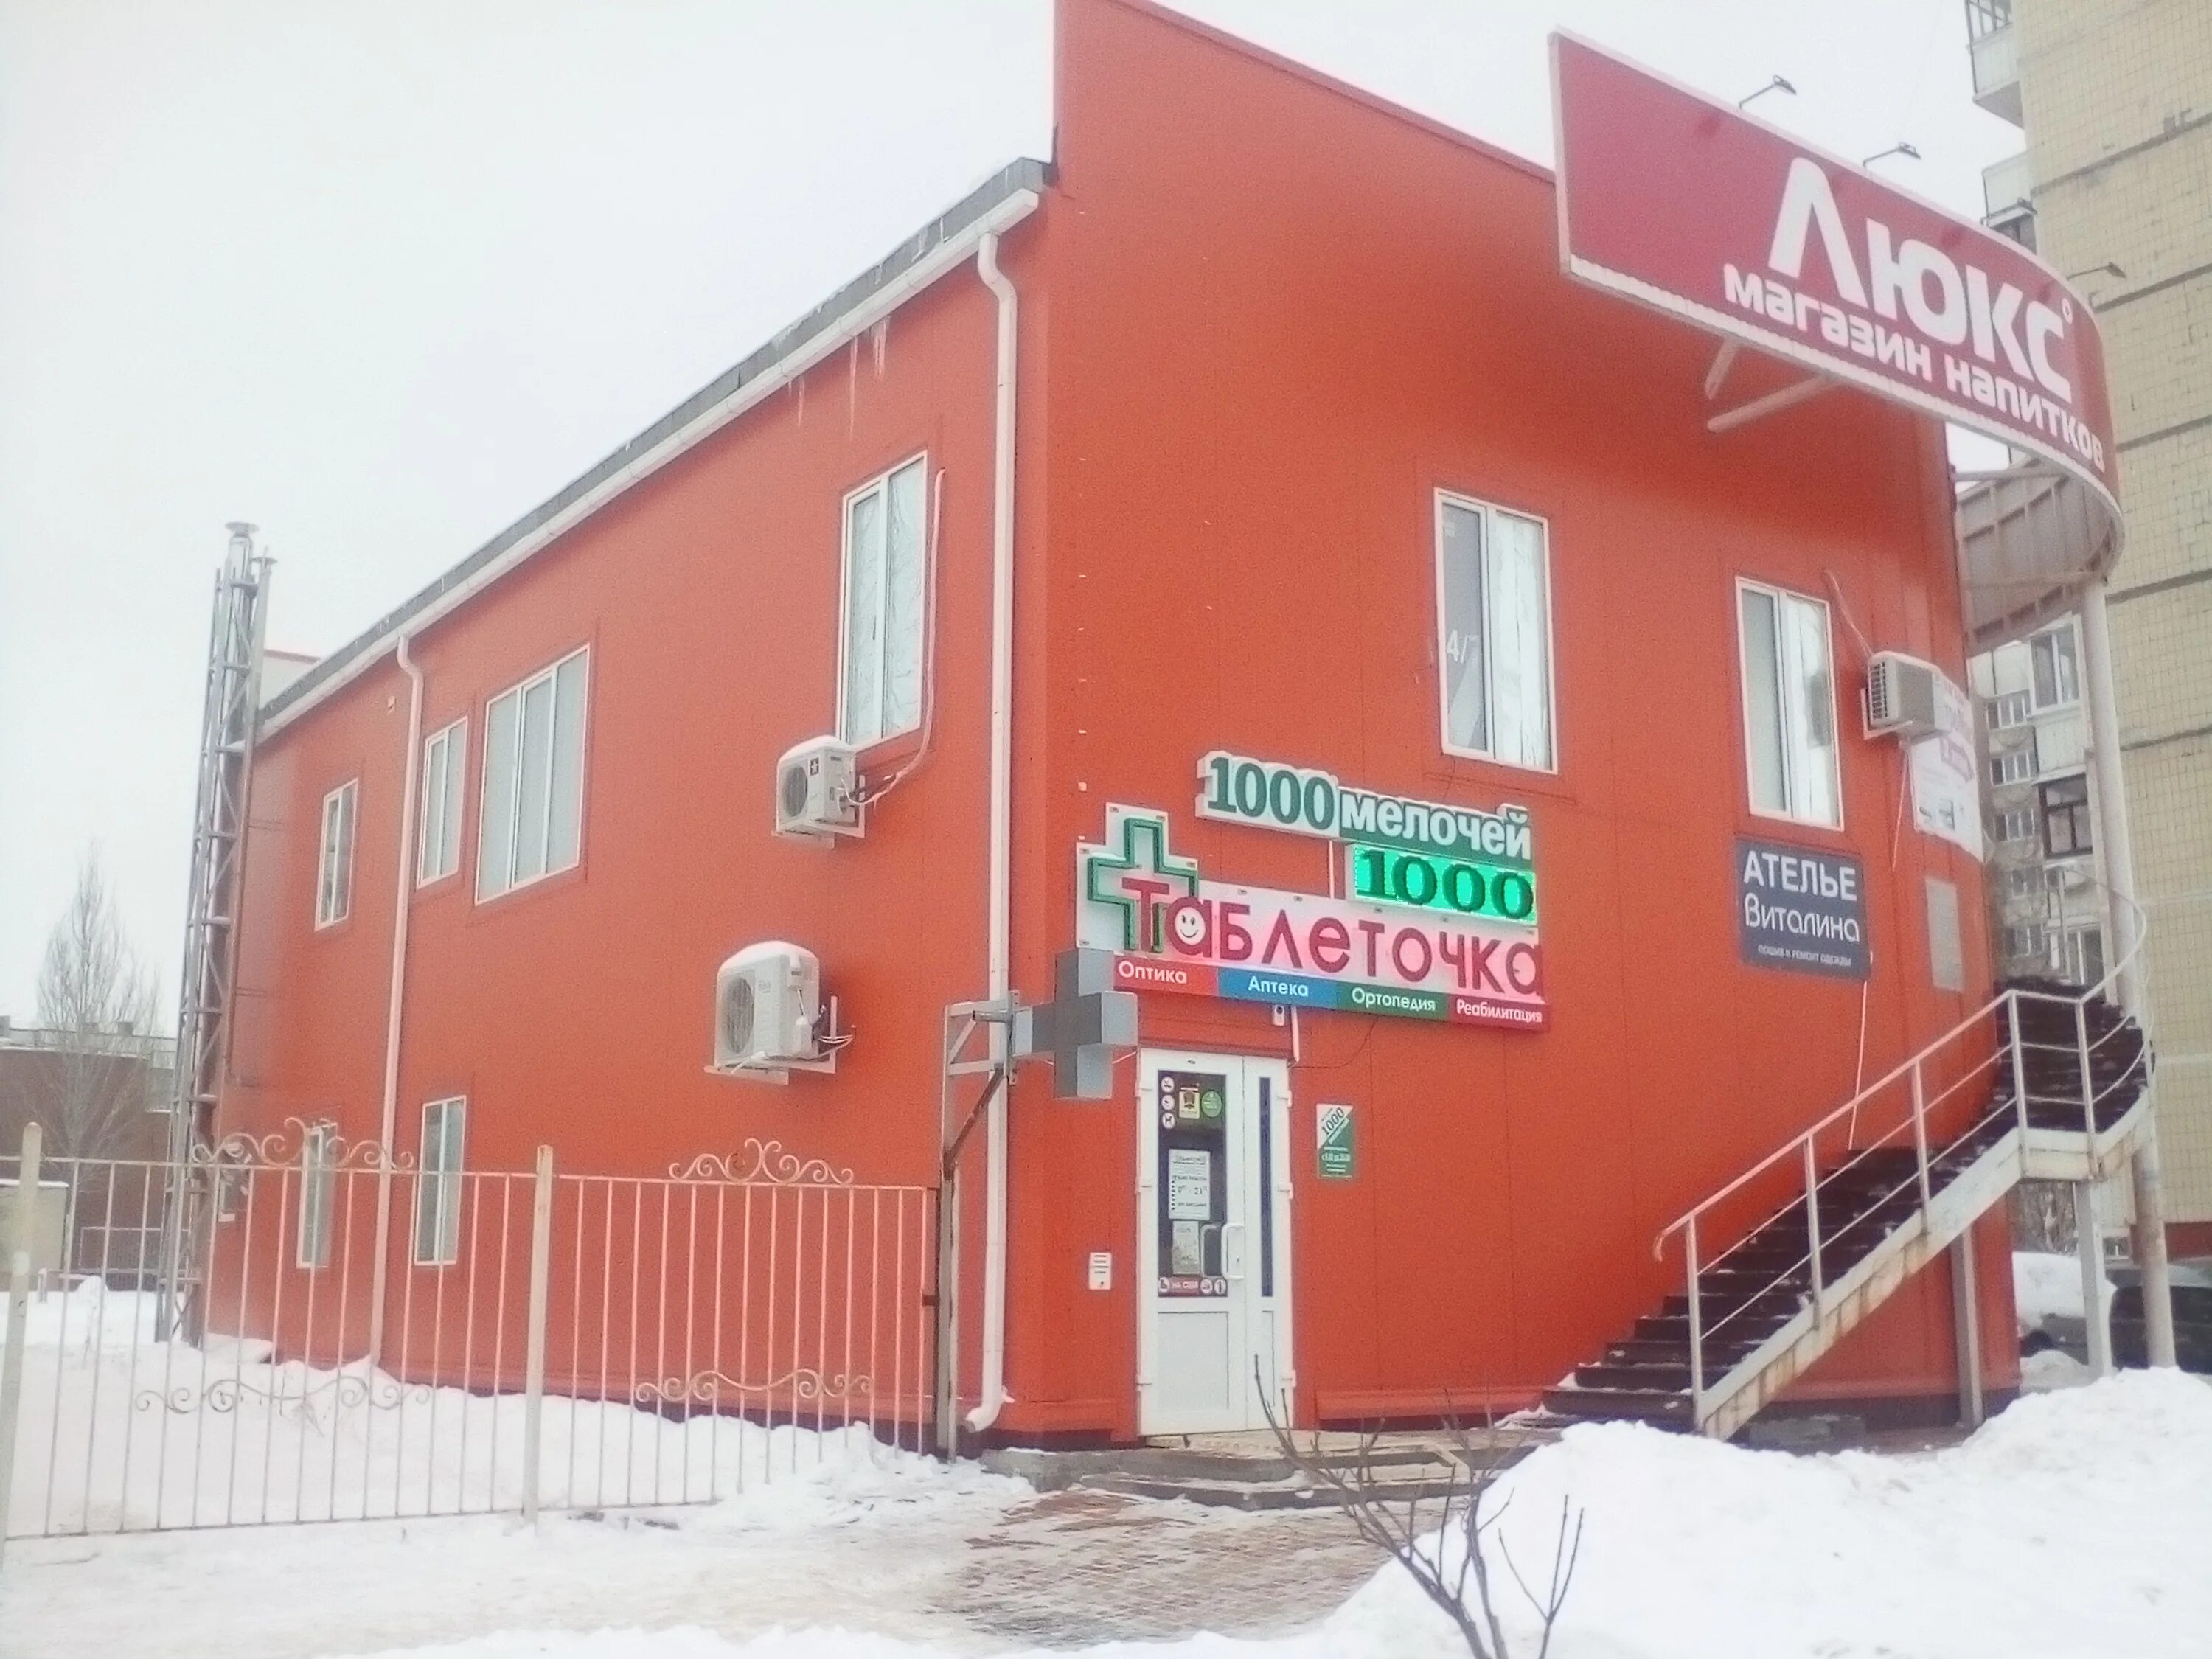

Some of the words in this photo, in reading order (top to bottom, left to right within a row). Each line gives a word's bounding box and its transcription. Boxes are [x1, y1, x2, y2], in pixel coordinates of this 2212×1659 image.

[1724, 263, 1932, 380] магазин
[1946, 354, 2105, 472] напитков
[1208, 756, 1335, 830] 1000
[1339, 791, 1532, 860] мелочей
[1355, 847, 1535, 921] 1000
[1743, 850, 1857, 902] АТЕЛЬЕ
[1745, 892, 1860, 942] Виталина
[1118, 960, 1187, 984] Оптика
[1248, 975, 1309, 997] Аптека
[1352, 987, 1436, 1012] Ортопедия
[1456, 999, 1543, 1023] Реабилитация
[1322, 1107, 1344, 1134] 1000
